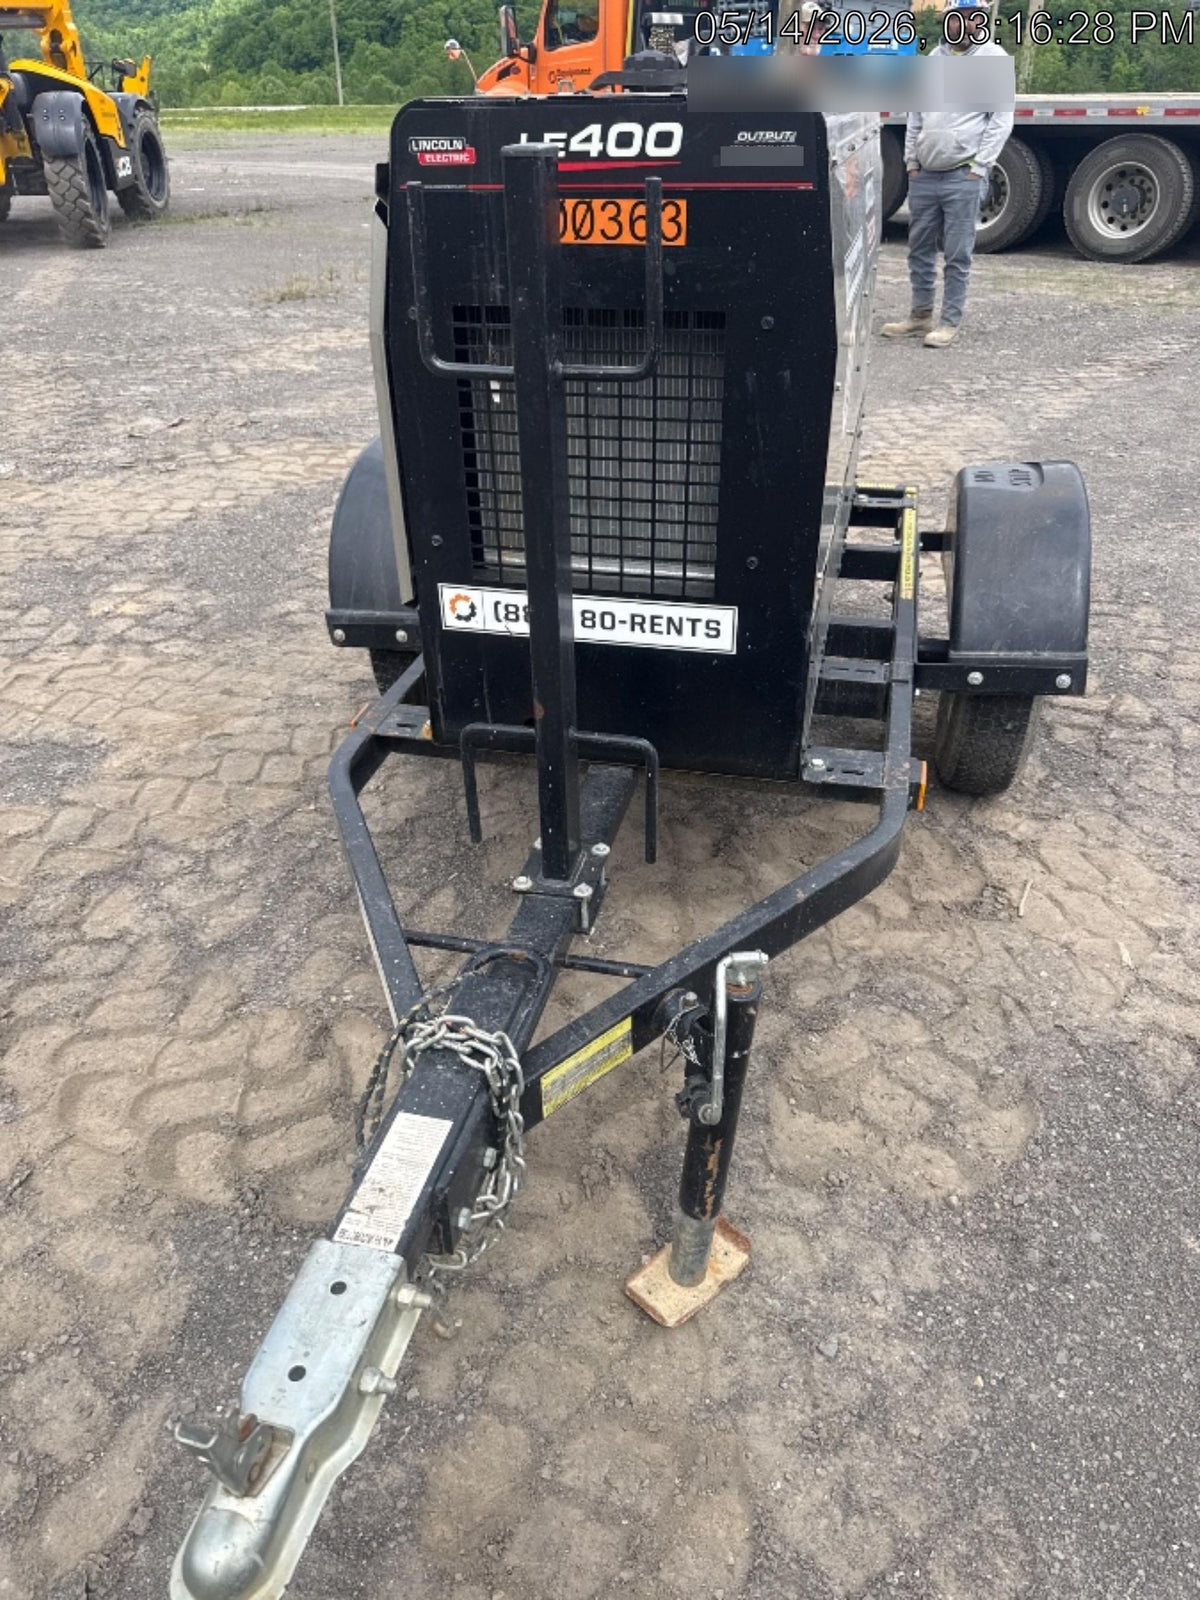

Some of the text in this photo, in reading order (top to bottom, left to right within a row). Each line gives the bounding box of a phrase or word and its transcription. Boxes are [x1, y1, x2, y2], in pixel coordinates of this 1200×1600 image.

[737, 131, 796, 142] OUTPUT
[411, 140, 463, 151] LINCOLN
[425, 152, 470, 163] ELECTRIC
